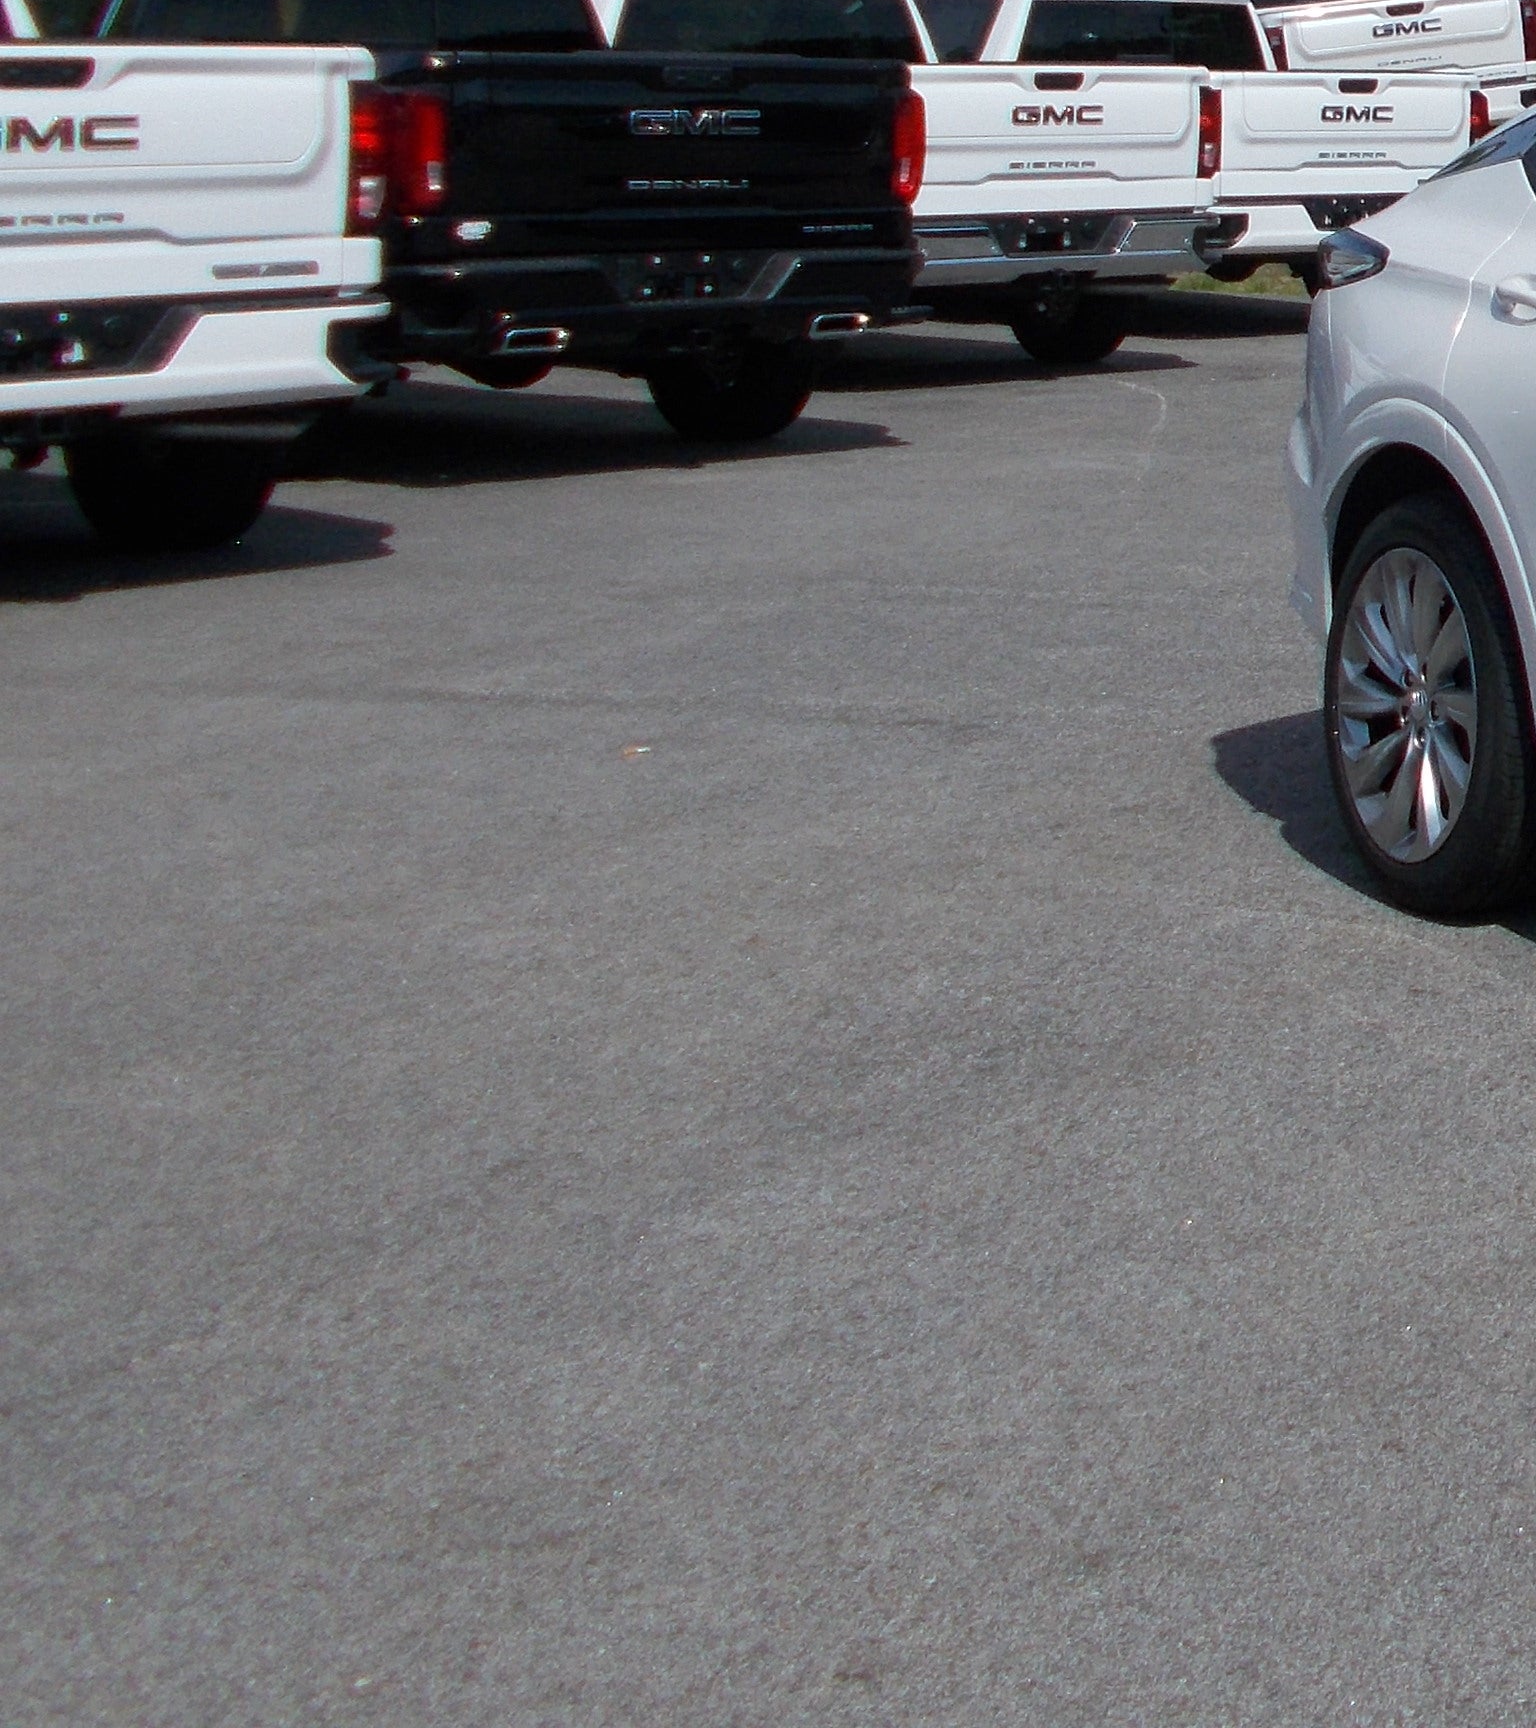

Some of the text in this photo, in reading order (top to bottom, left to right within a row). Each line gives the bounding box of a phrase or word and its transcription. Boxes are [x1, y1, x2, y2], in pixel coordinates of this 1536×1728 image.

[1372, 18, 1442, 38] GMC
[1377, 55, 1442, 67] DENALI
[630, 110, 761, 135] GMC
[1012, 105, 1104, 126] GMC
[1321, 106, 1394, 123] GMC
[0, 115, 140, 153] MC
[1009, 161, 1096, 169] SIERRA
[628, 180, 749, 189] DENALI
